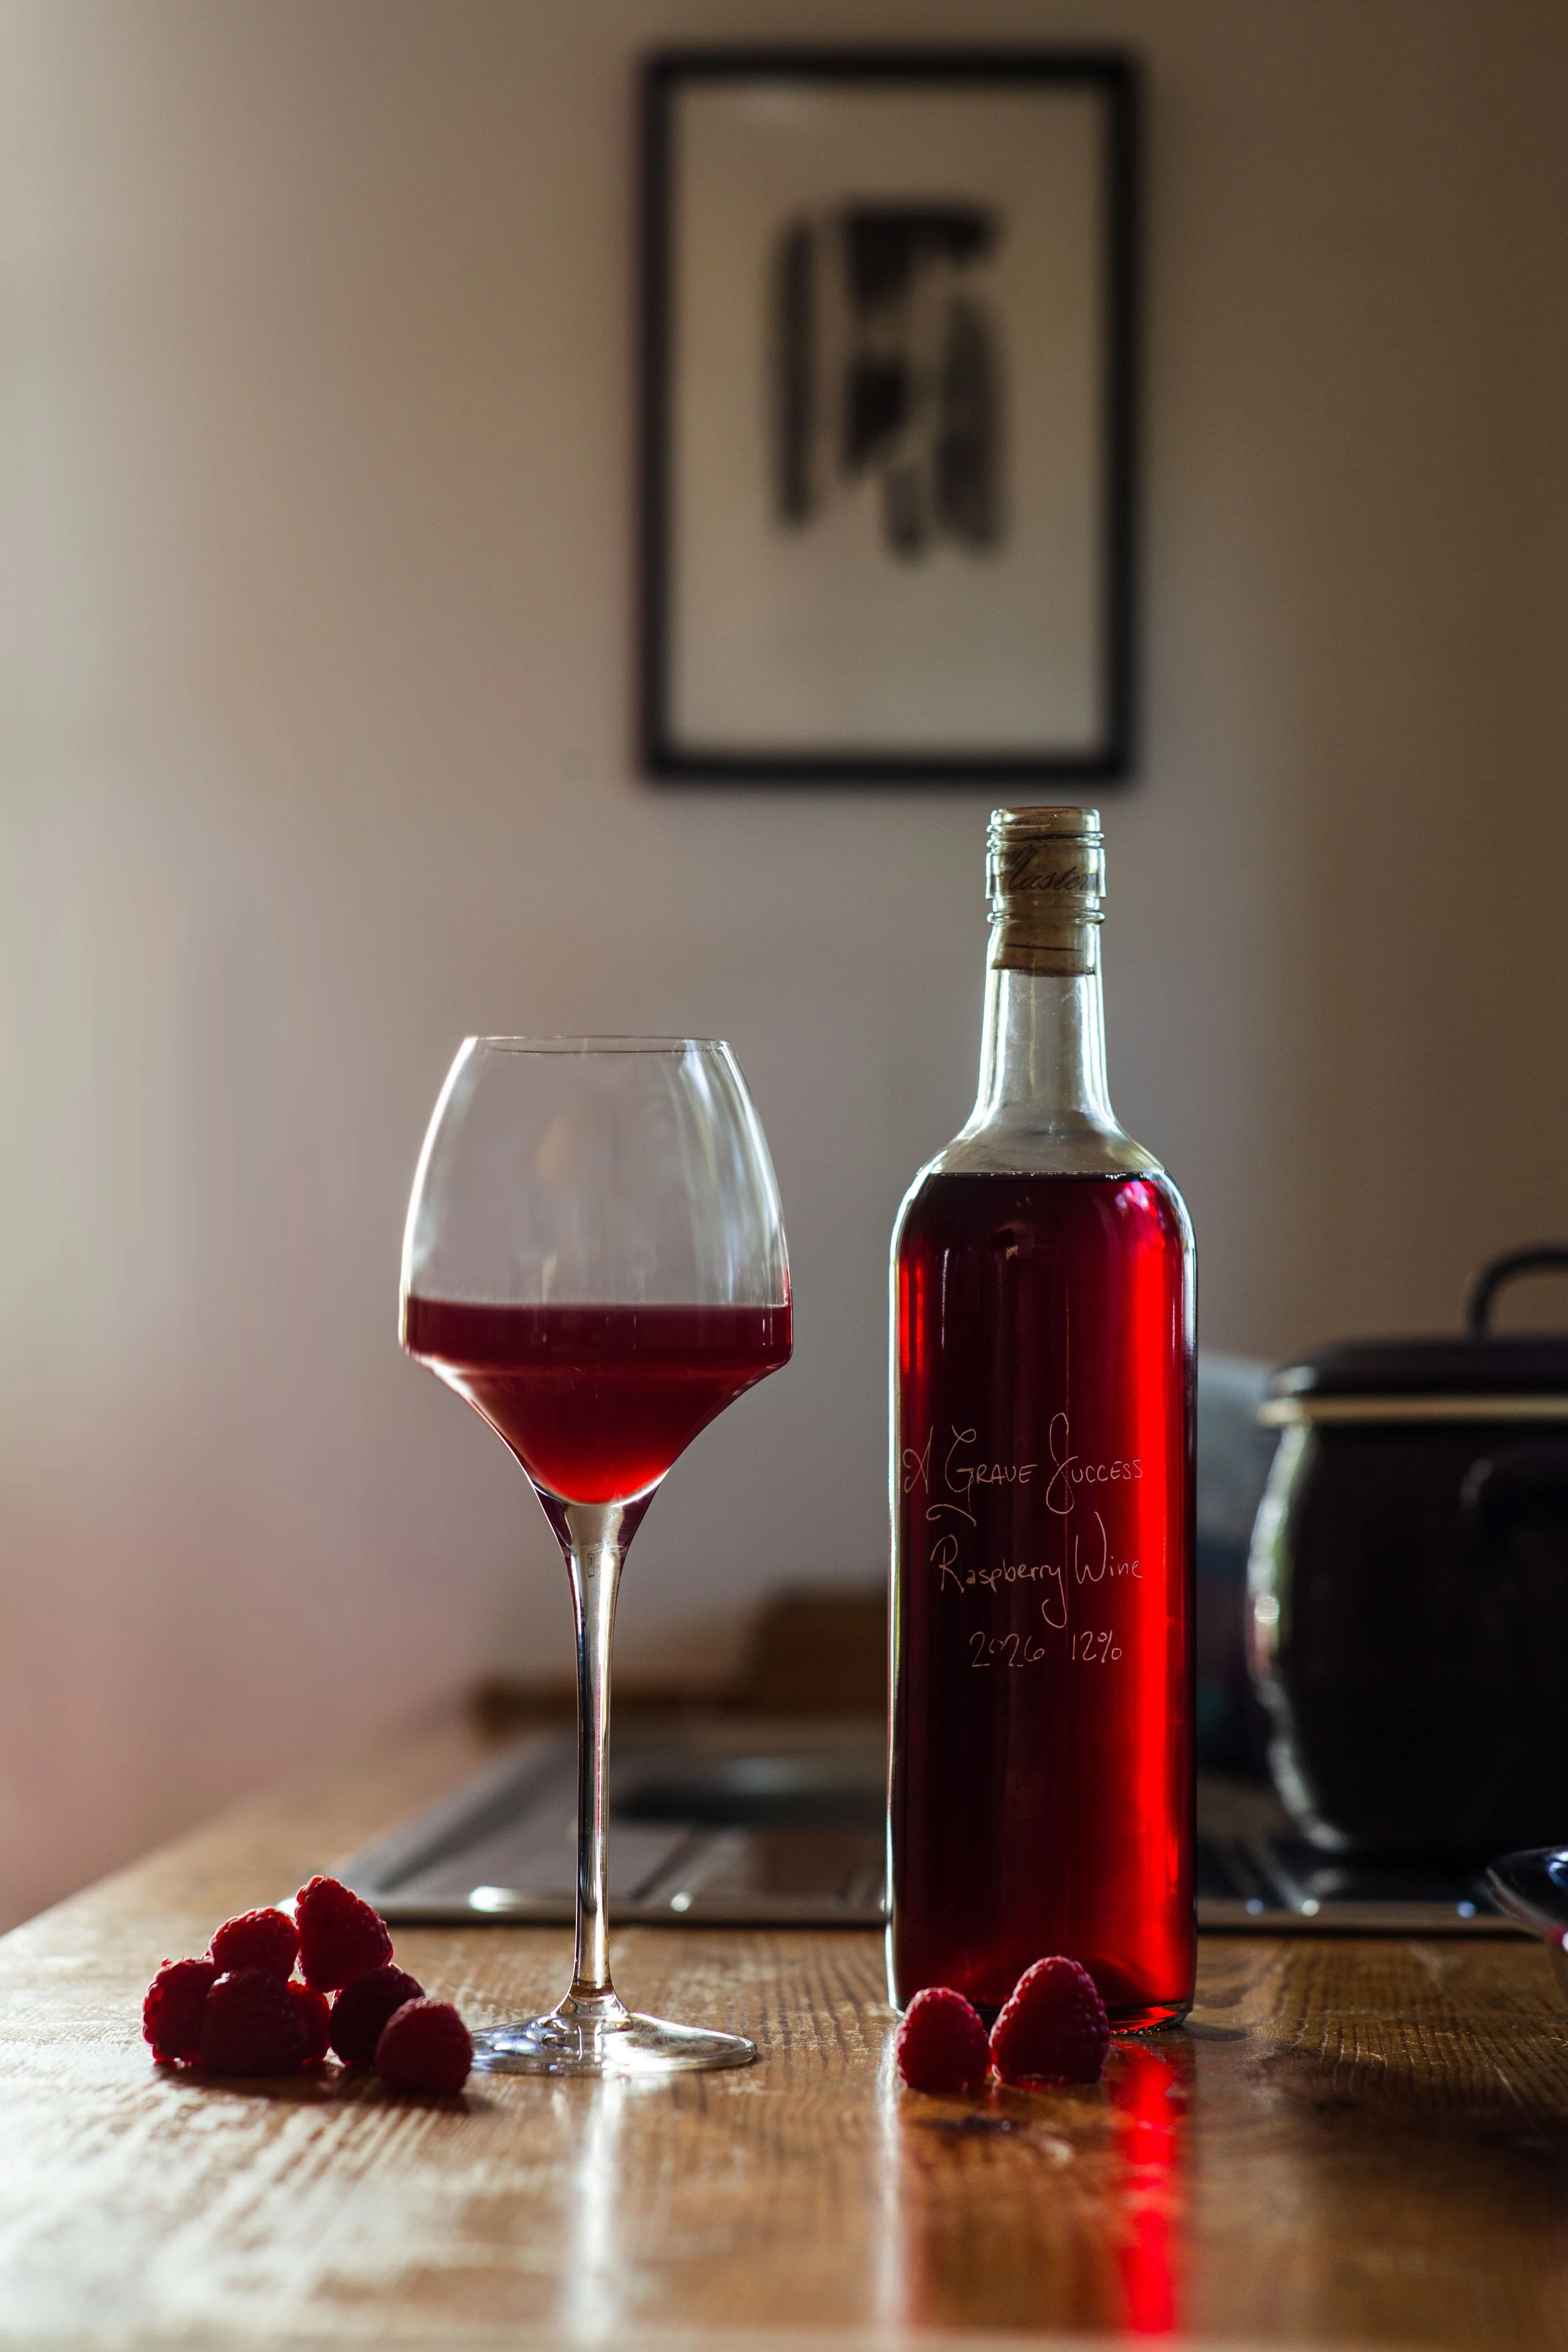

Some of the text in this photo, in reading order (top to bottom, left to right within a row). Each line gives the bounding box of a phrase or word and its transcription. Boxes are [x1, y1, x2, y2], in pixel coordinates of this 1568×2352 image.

[903, 1425, 933, 1493] A
[1046, 1412, 1143, 1514] SUCCESS
[930, 1512, 1143, 1629] Raspberry Wine
[970, 1630, 1122, 1667] 2026 12%
